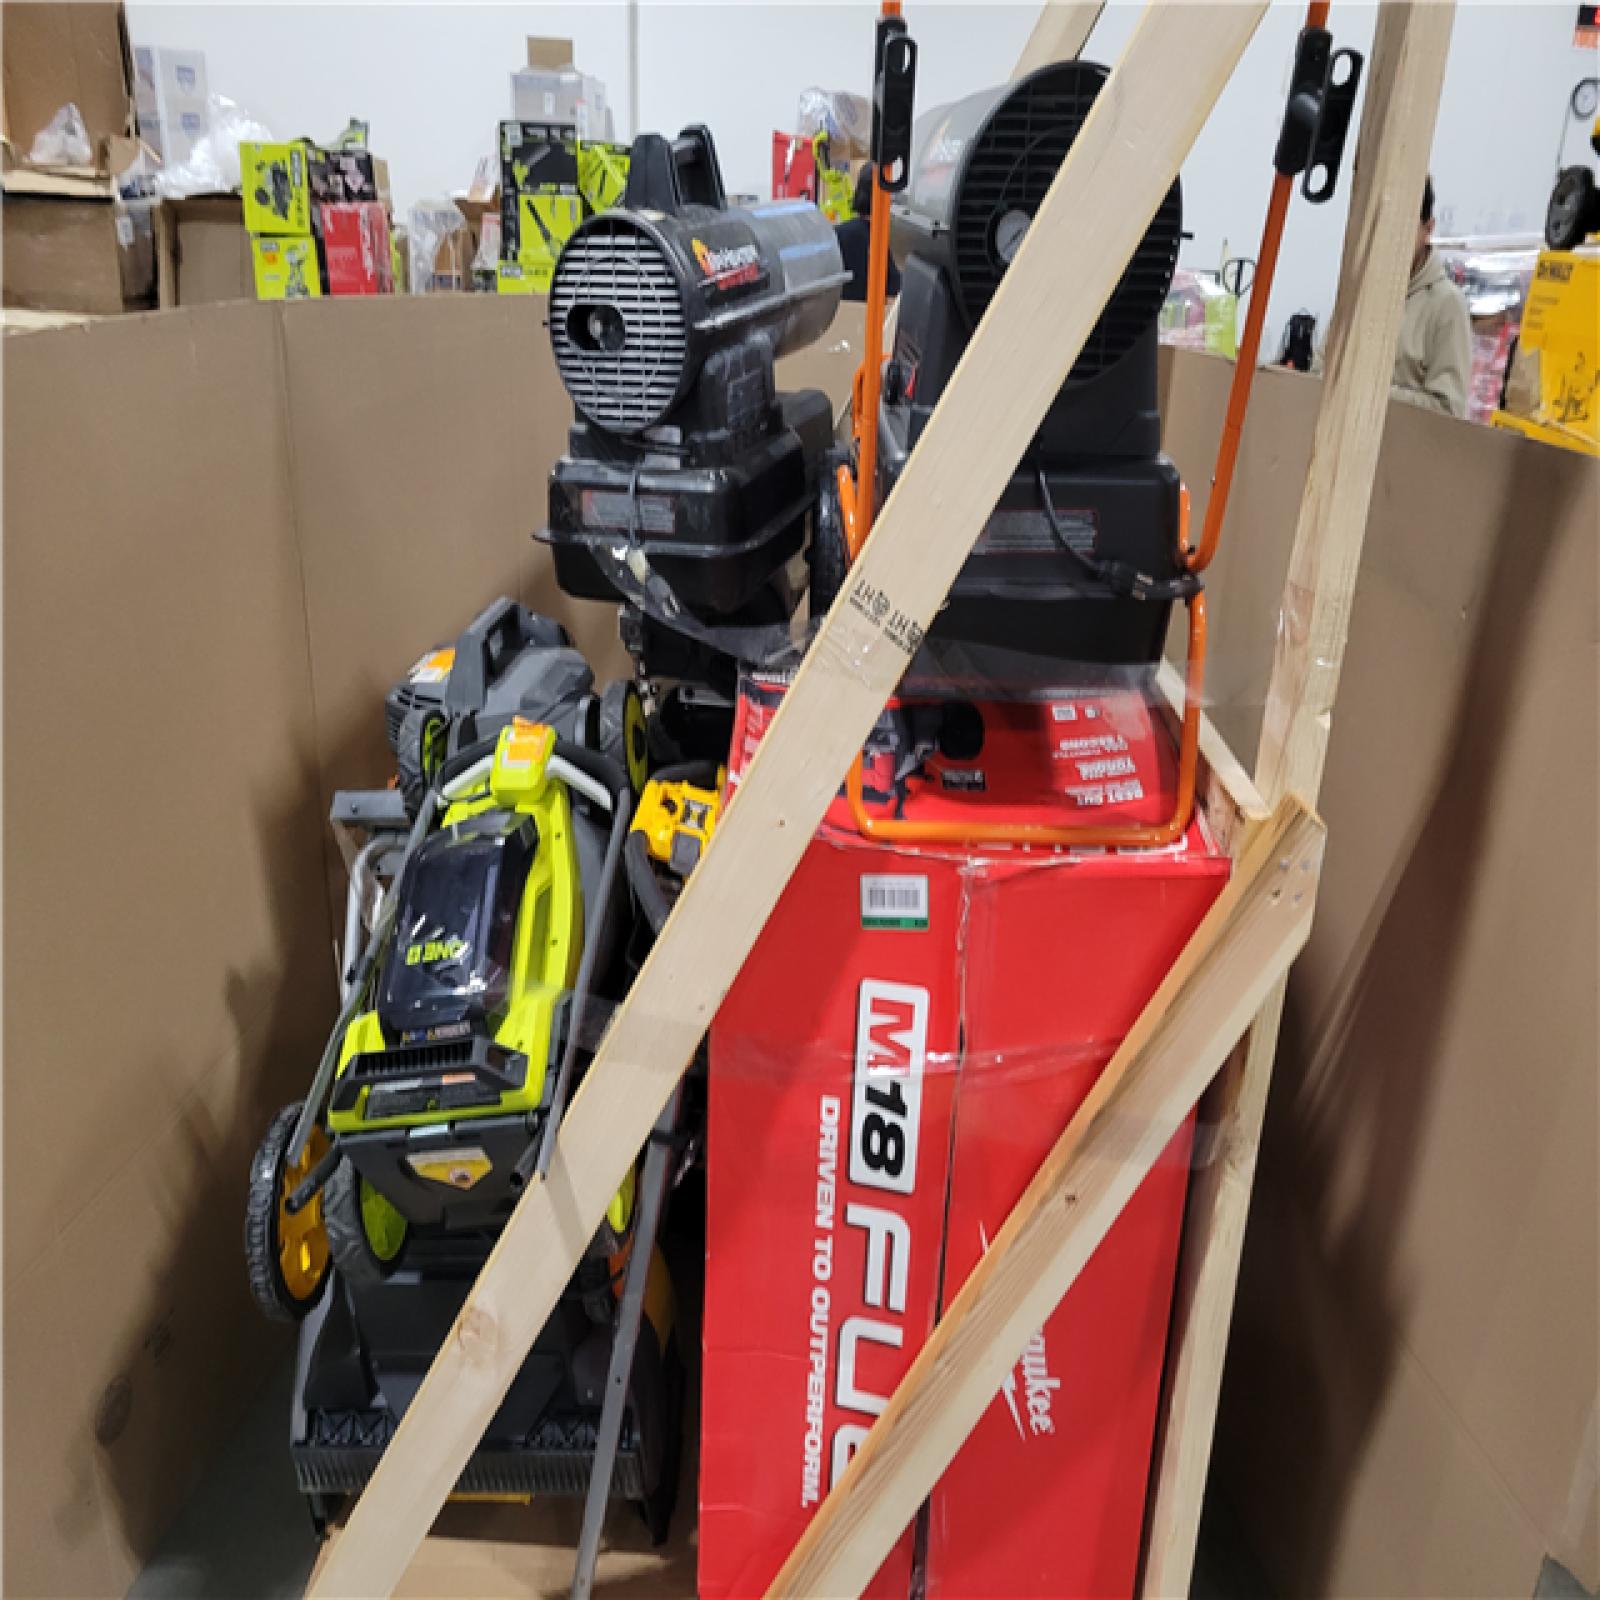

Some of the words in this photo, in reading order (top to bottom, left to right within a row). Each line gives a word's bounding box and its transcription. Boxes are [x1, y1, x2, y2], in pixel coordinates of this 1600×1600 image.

[815, 1096, 840, 1229] DRIVEN
[862, 997, 914, 1178] M18
[812, 1235, 833, 1280] TO
[829, 1201, 911, 1494] FU
[800, 1286, 831, 1508] OUTPERFORM.
